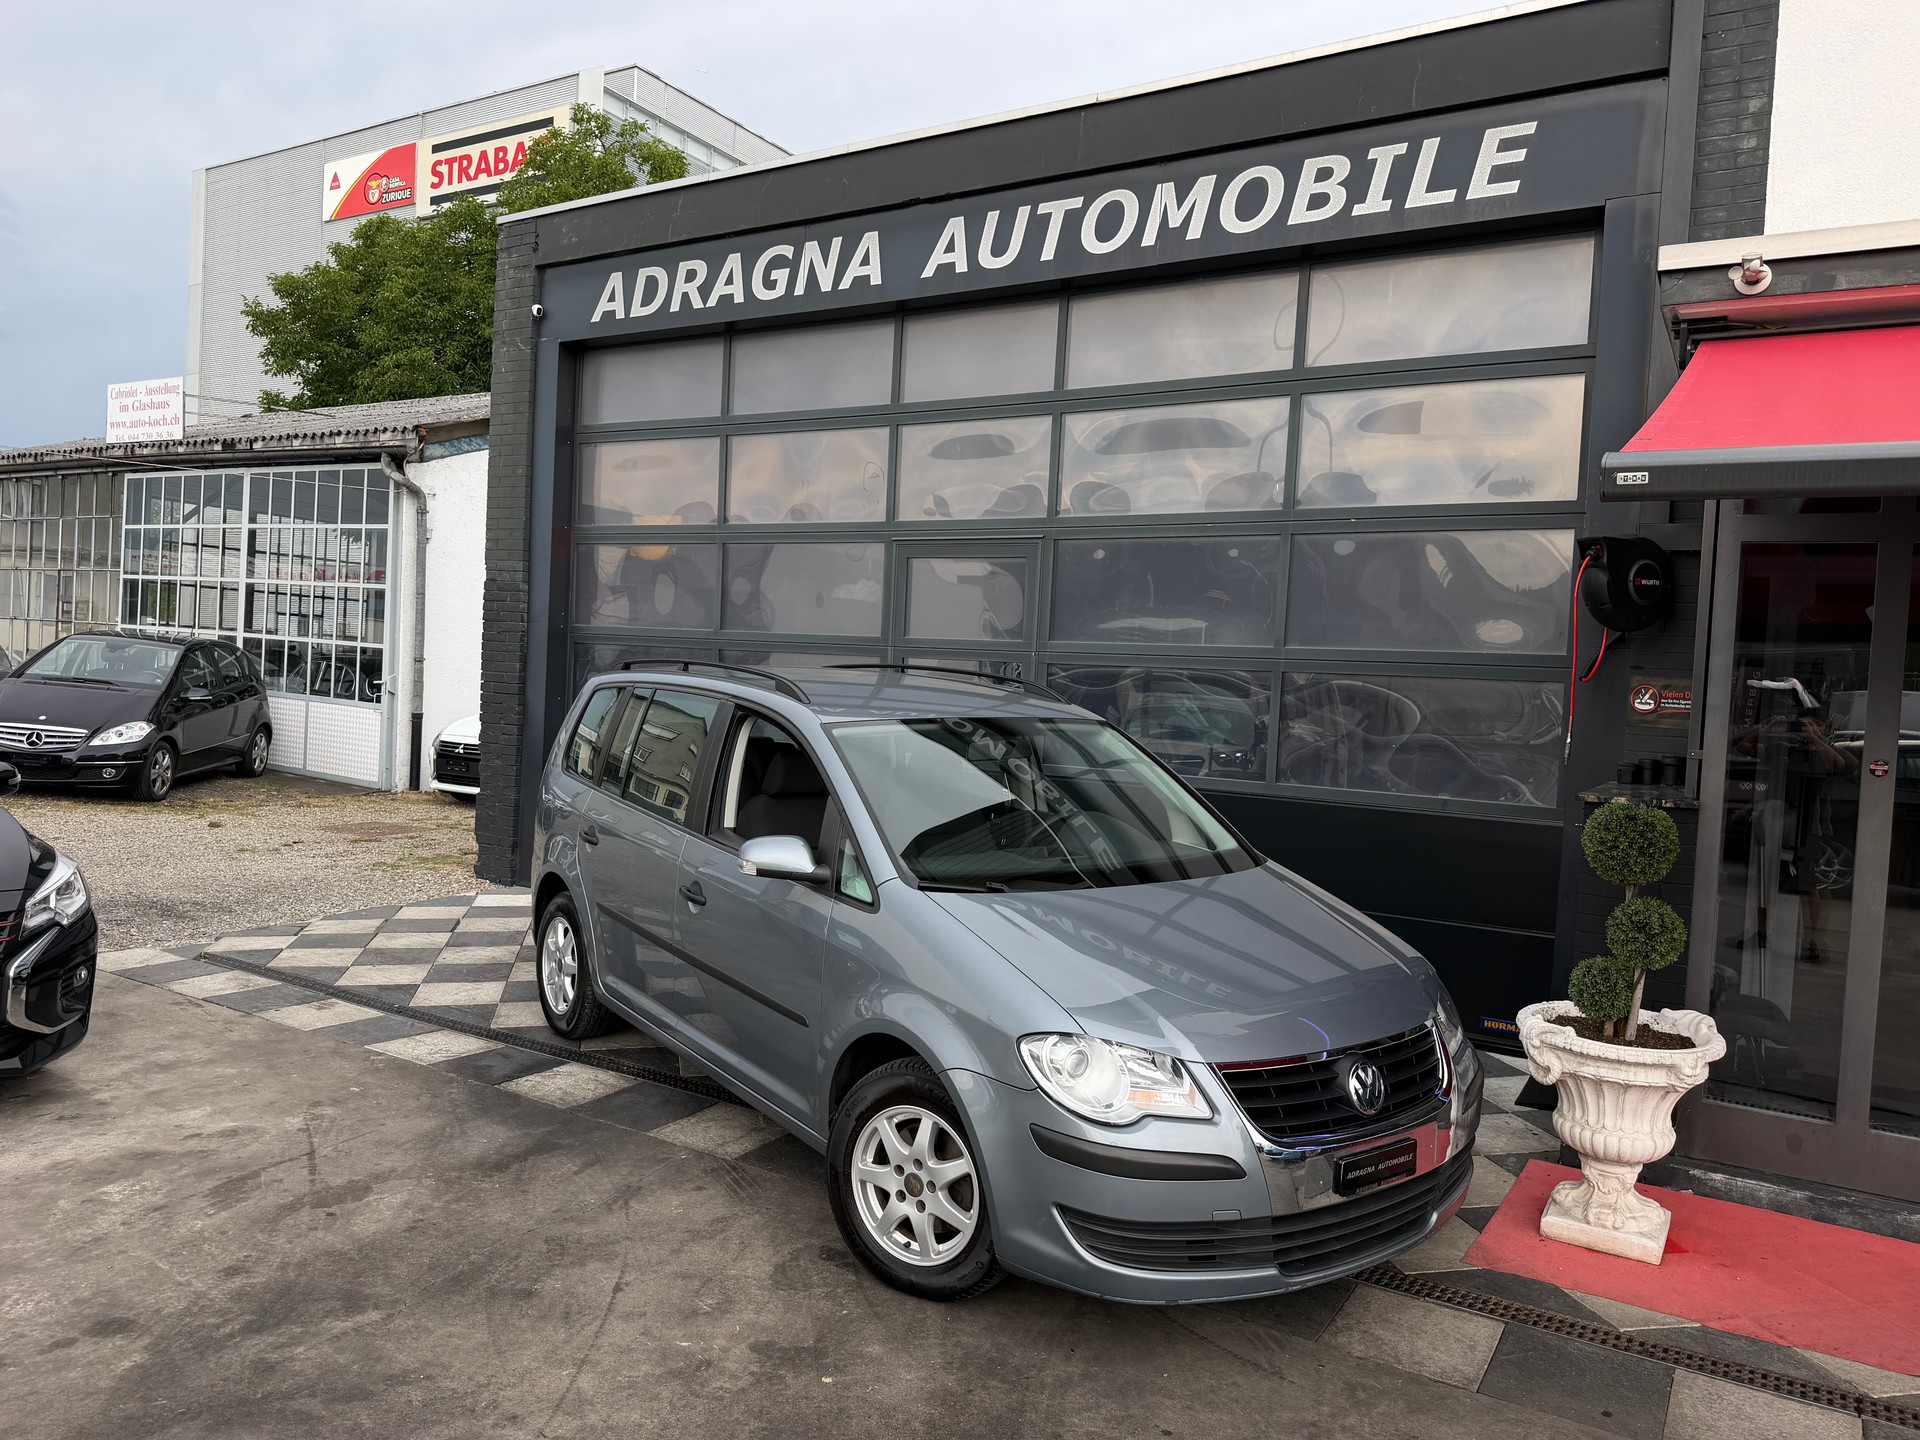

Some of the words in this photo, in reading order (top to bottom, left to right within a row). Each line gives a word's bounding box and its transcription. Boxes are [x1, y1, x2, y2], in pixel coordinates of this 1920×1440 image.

[429, 141, 534, 190] STRABA
[381, 188, 412, 204] ZURIQUE
[590, 230, 882, 323] ADRAGNA
[920, 121, 1538, 279] AUTOMOBILE
[110, 386, 138, 400] Cabriolet
[144, 382, 180, 397] Ausstellung
[119, 401, 129, 413] im
[132, 398, 170, 412] Glashaus
[109, 413, 180, 430] www.auto-koch.ch
[1661, 690, 1684, 699] Vielen
[1685, 691, 1692, 699] D
[1743, 671, 1761, 728] MERBG
[1346, 1165, 1375, 1180] ADRAGNA
[1377, 1153, 1413, 1170] AUTOMOBILE
